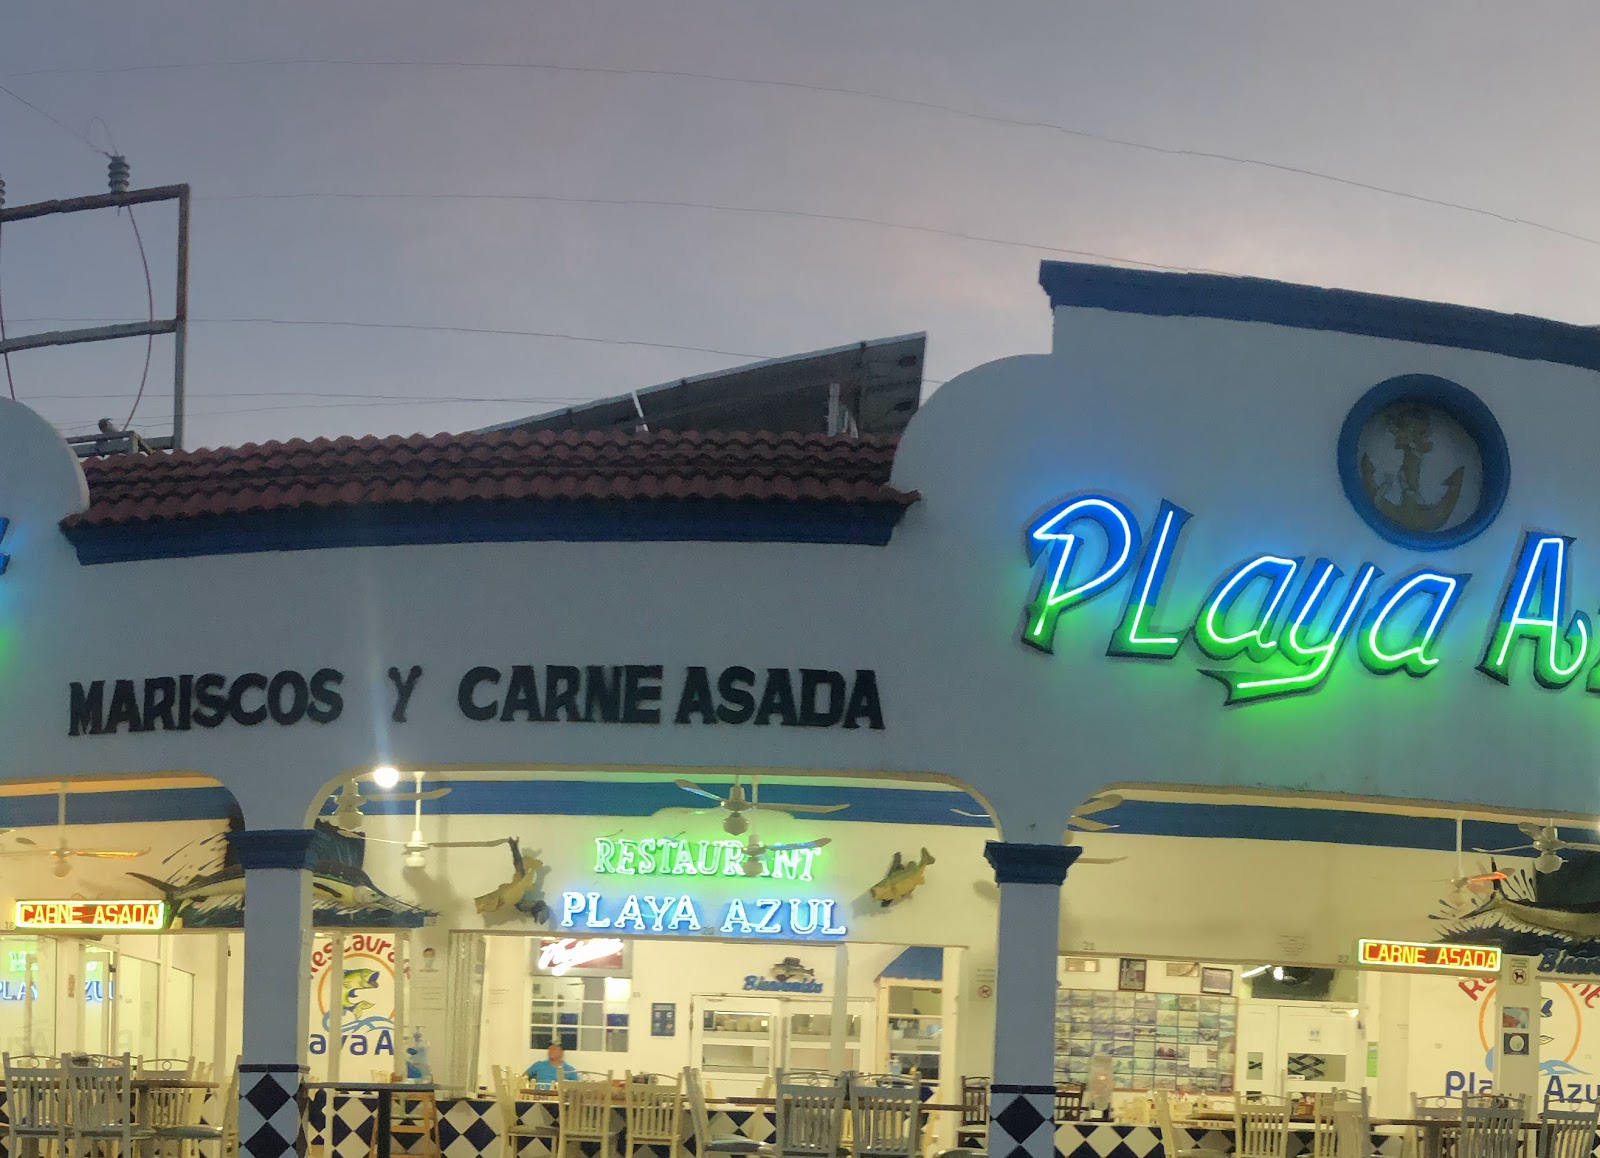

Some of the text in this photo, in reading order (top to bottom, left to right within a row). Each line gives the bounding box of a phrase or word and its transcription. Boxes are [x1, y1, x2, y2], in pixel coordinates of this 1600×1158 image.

[68, 664, 886, 737] MARISCOS Y CARNE ASADA
[20, 903, 159, 925] CARNE ASADA
[560, 891, 847, 935] PLAYA AZUL
[1363, 943, 1427, 963] CARNE
[1436, 947, 1498, 969] ASADA
